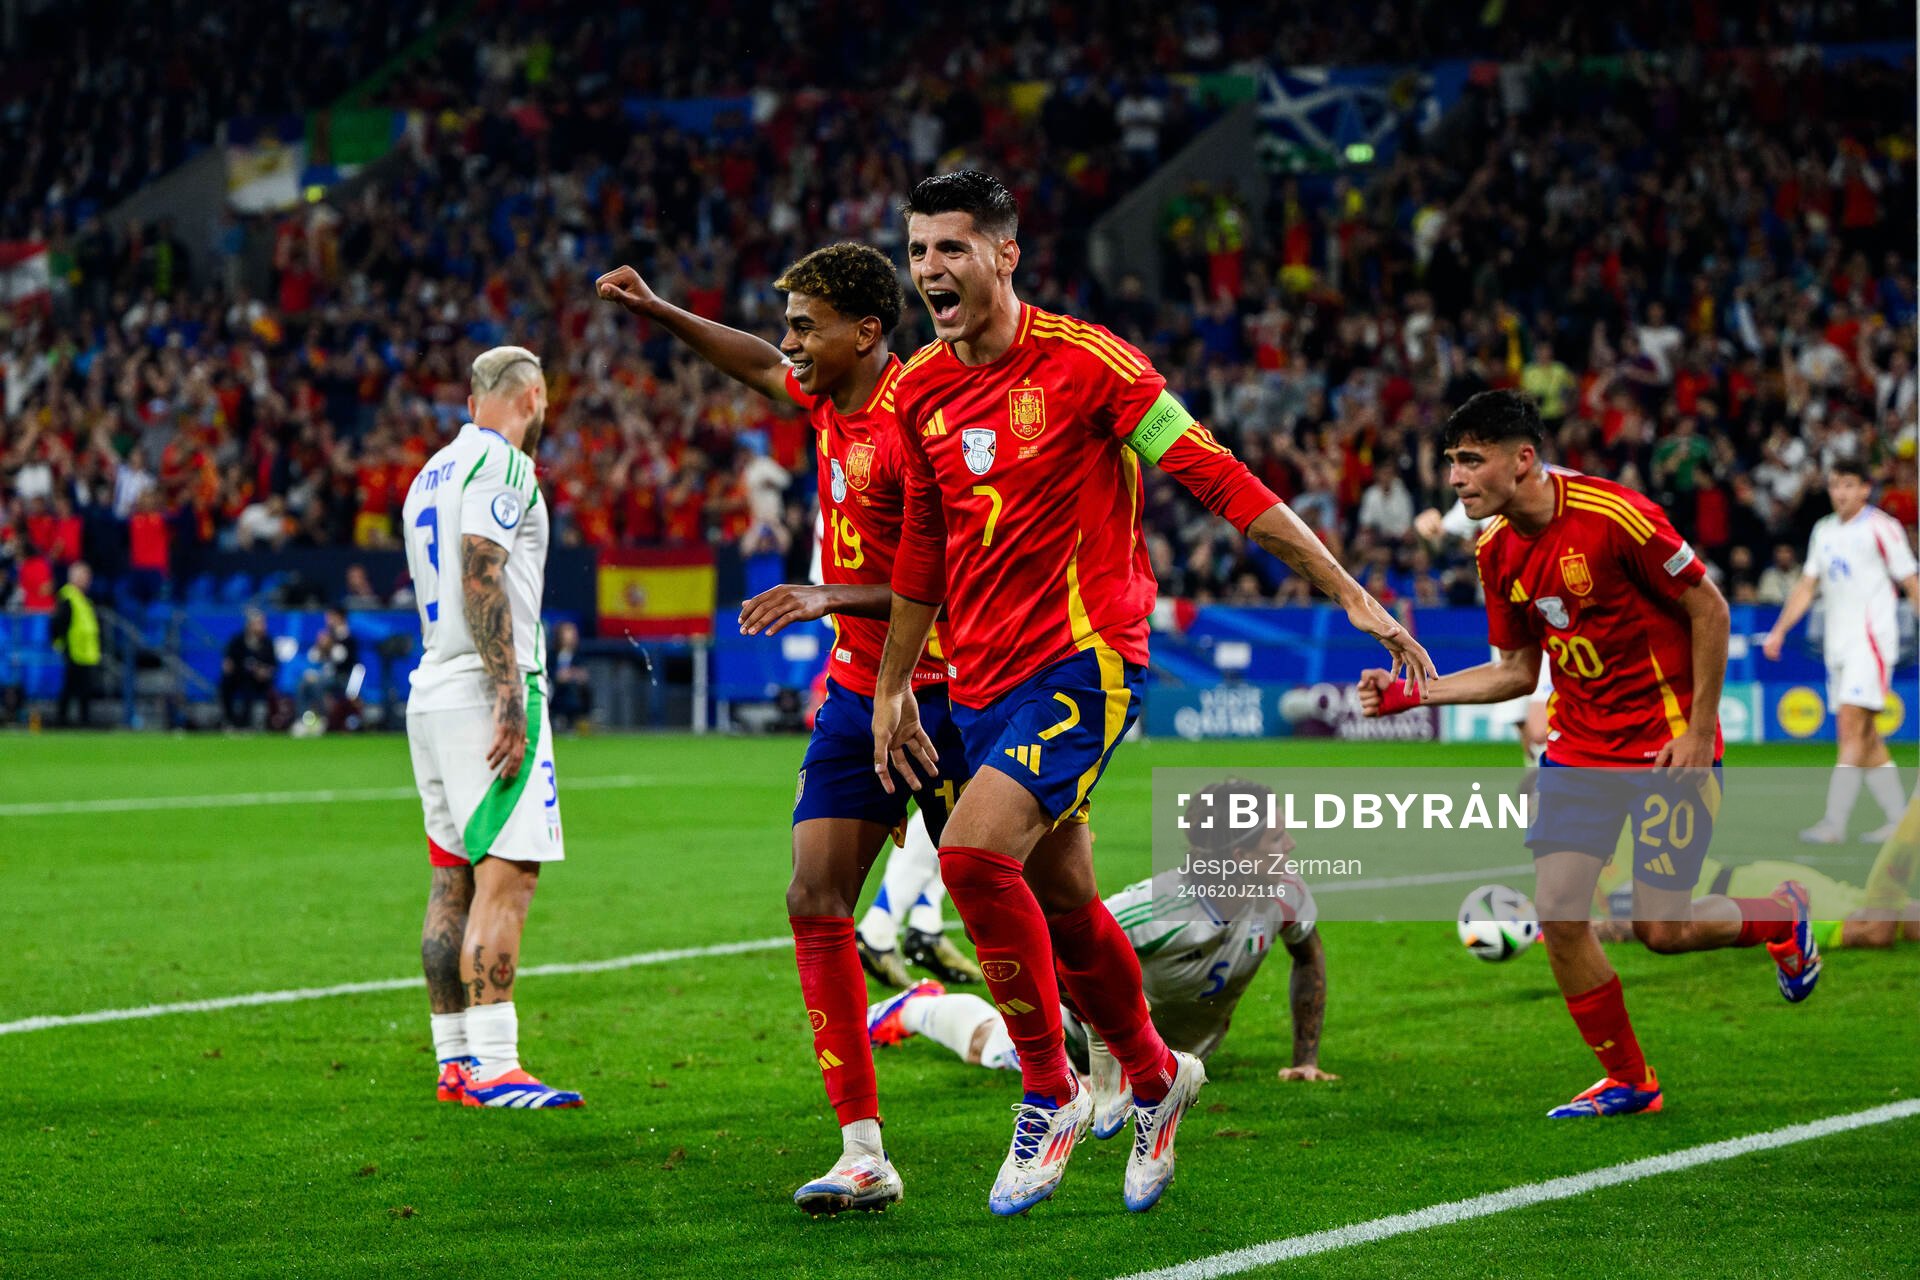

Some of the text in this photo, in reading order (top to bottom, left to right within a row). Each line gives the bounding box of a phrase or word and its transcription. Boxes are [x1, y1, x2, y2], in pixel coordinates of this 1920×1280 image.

[1141, 406, 1178, 443] RESPECT
[830, 508, 865, 570] 19
[972, 485, 1003, 547] 7
[1548, 635, 1604, 678] 20
[1037, 691, 1080, 741] 7
[541, 761, 556, 807] 3
[1639, 793, 1694, 849] 20
[1200, 961, 1230, 998] 5
